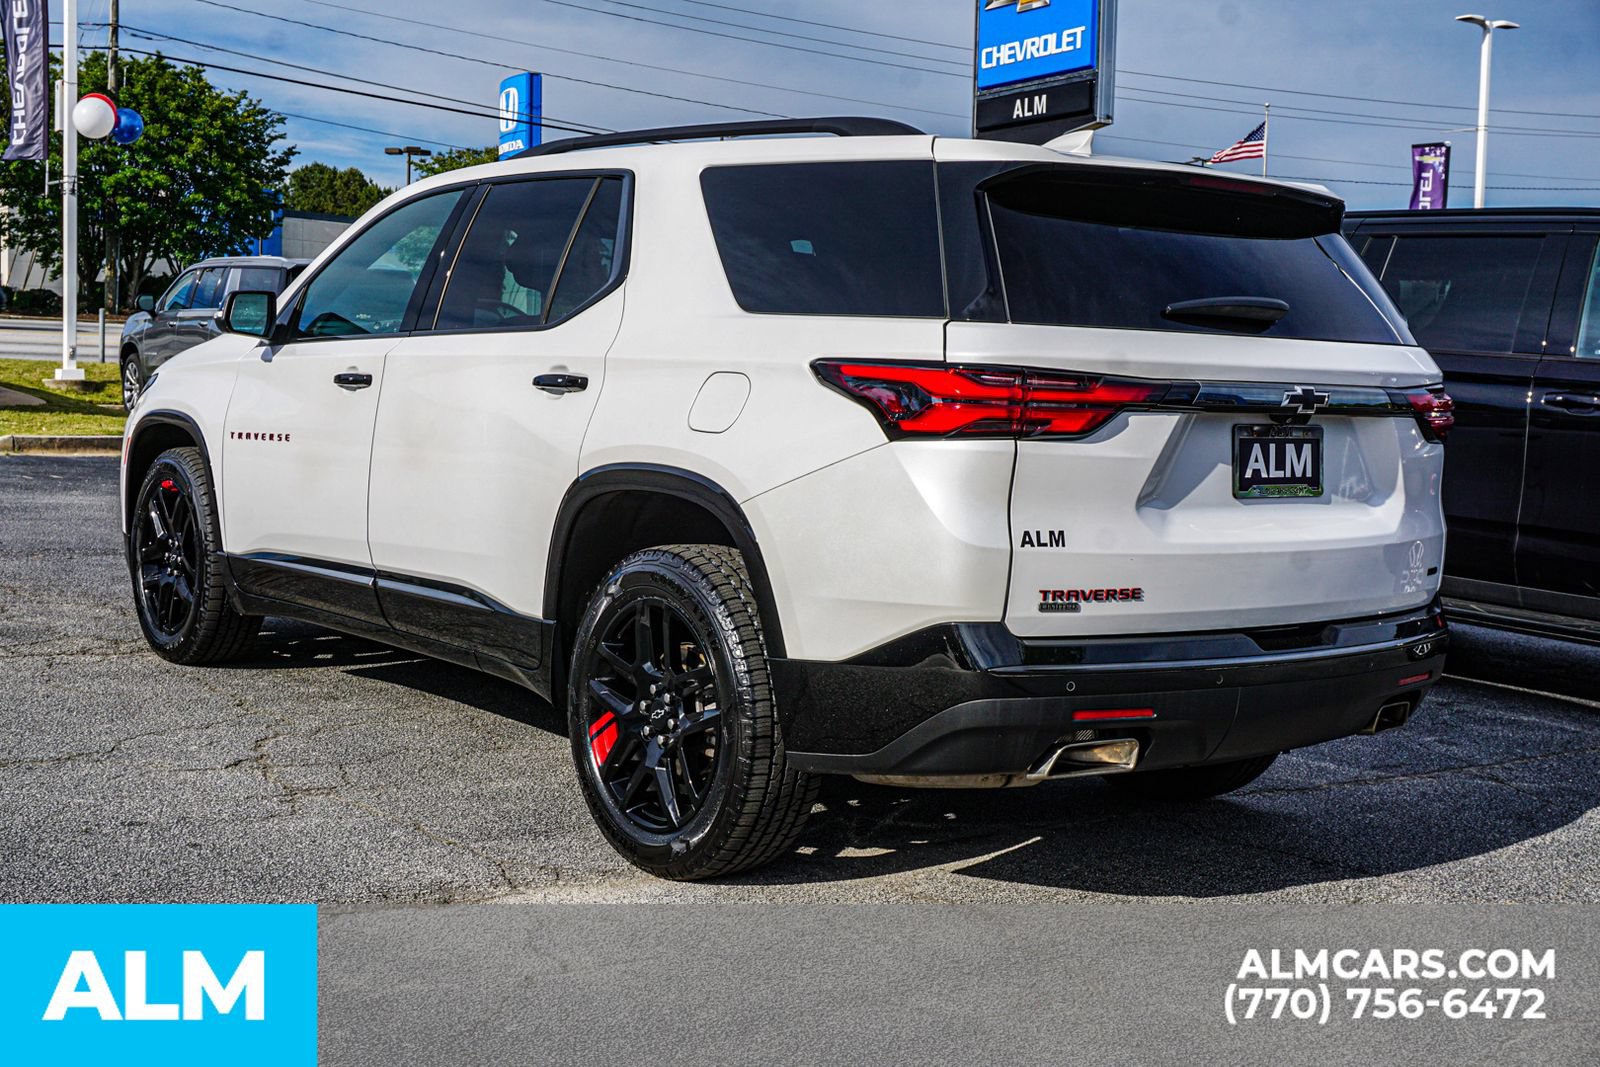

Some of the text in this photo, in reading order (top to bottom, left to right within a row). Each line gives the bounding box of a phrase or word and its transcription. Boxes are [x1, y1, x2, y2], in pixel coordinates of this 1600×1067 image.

[981, 25, 1087, 70] CHEVROLET
[1012, 94, 1048, 119] ALM
[230, 431, 291, 442] TRAVERSE
[1244, 442, 1312, 478] ALM
[1020, 530, 1066, 548] ALM
[1039, 587, 1145, 603] TRAVERSE
